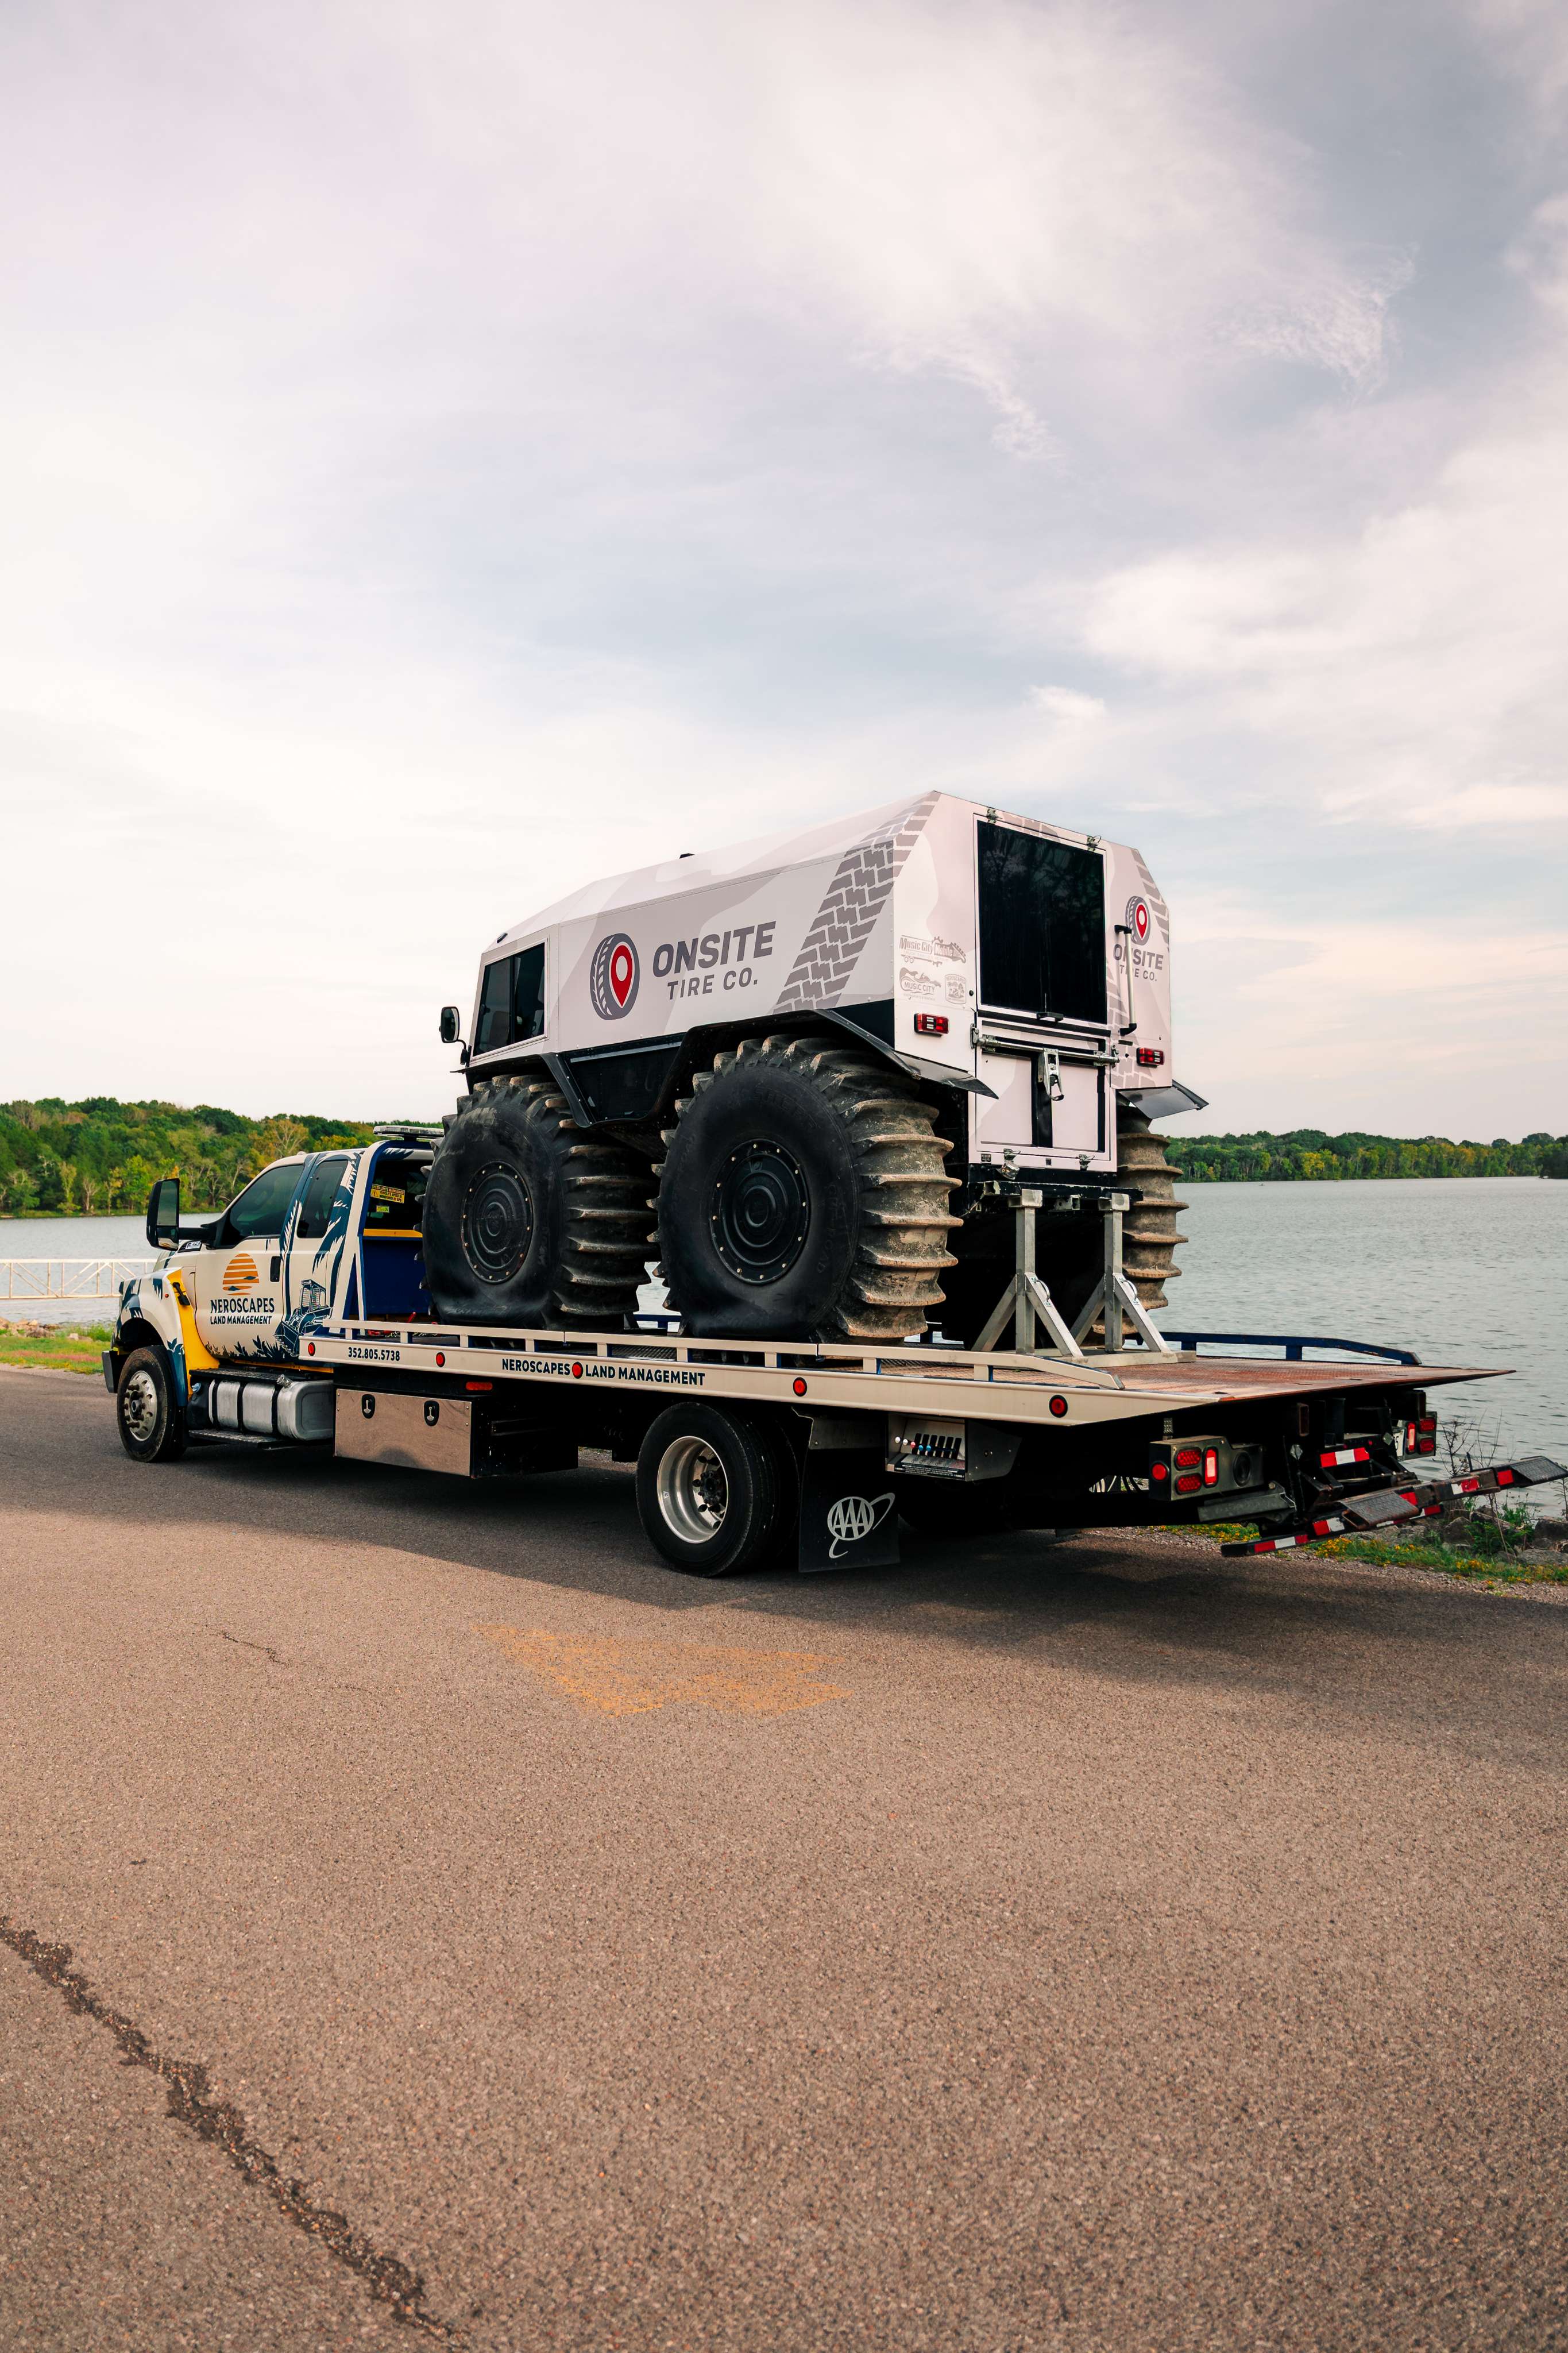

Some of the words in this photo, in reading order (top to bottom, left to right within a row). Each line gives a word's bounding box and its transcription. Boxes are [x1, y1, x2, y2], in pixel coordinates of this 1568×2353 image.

[652, 921, 776, 977] ONSITE
[899, 938, 921, 951] Music
[921, 942, 933, 955] City
[934, 943, 953, 956] Mobile
[667, 974, 715, 1000] TIRE
[723, 967, 758, 990] CO.
[1143, 970, 1157, 981] CO.
[904, 982, 922, 991] MUSIC
[922, 985, 935, 993] CITY
[210, 1298, 275, 1313] NEROSCAPES
[210, 1316, 226, 1325] LAND
[227, 1316, 272, 1325] MANAGEMENT
[348, 1347, 400, 1361] 352.805.5738
[502, 1359, 570, 1376] NEROSCAPES
[586, 1364, 616, 1379] LAND
[619, 1367, 705, 1386] MANAGEMENT
[831, 1497, 872, 1540] AAA
